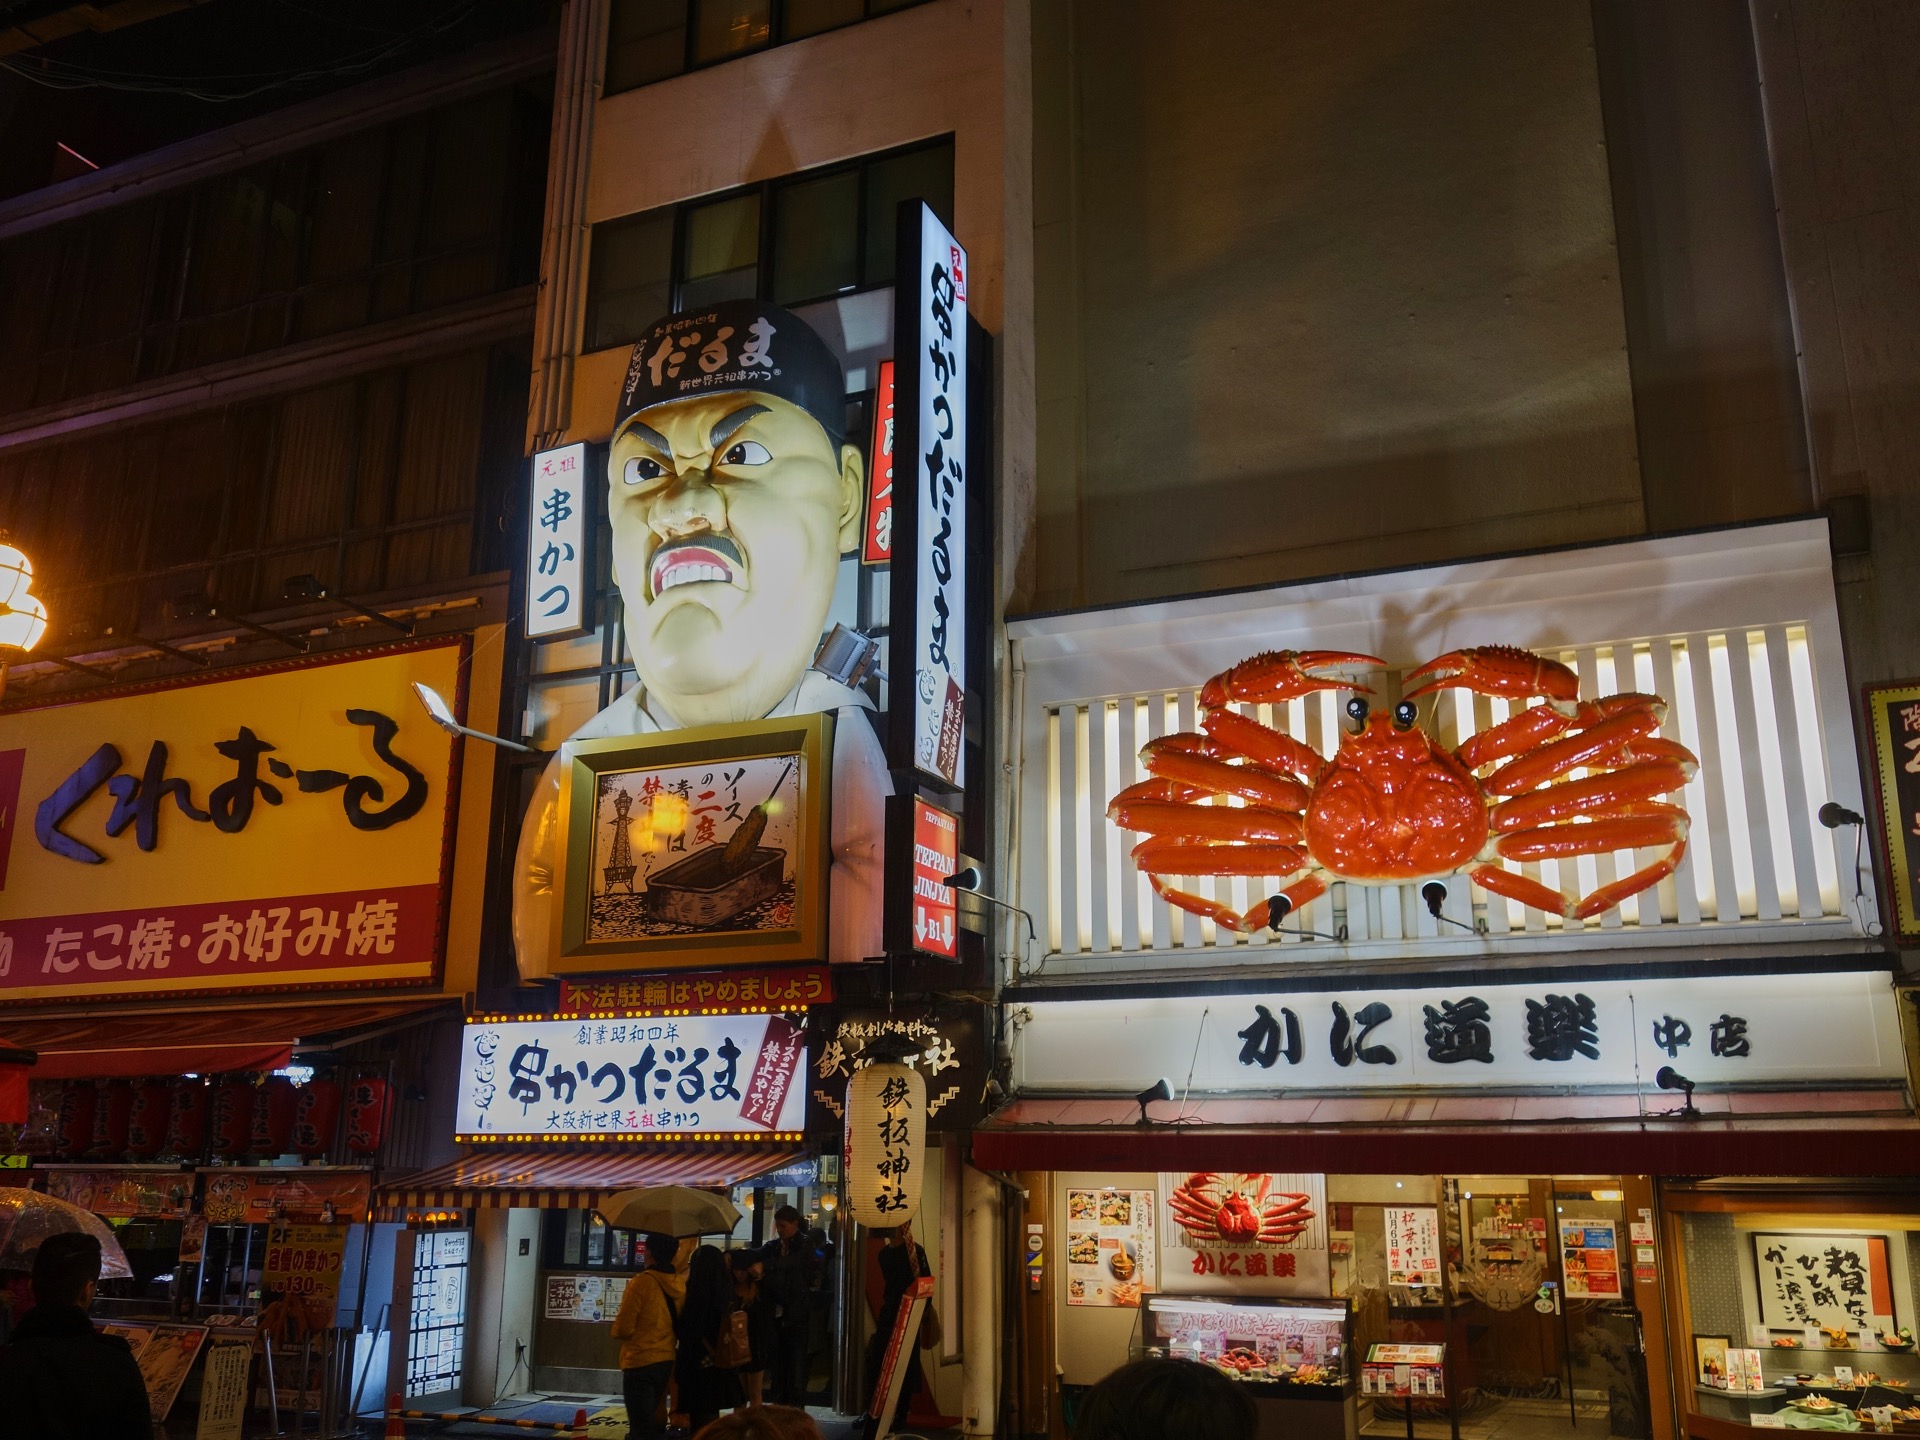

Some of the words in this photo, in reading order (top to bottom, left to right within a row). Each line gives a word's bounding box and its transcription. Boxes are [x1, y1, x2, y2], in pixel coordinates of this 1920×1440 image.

[647, 316, 777, 387] だるま
[540, 455, 577, 479] 元祖
[925, 262, 962, 673] 串かつだるま
[536, 488, 575, 617] 串かつ
[34, 708, 428, 865] くれおーる
[723, 767, 746, 822] ソース
[690, 772, 723, 847] の二度
[915, 843, 956, 875] TEPPAN
[914, 875, 951, 905] JINJYA
[928, 918, 941, 941] B1
[566, 977, 823, 1010] 不法駐輪はやめましょう
[575, 1023, 680, 1046] 創業昭和四年
[1652, 1012, 1753, 1058] 中店
[508, 1037, 742, 1117] 串かつだるま
[761, 1026, 804, 1125] ソースの二度漬けは
[546, 1109, 700, 1131] 大阪新世界元祖串かつ
[875, 1077, 912, 1214] 鉄板神社
[271, 1228, 292, 1243] 2F
[267, 1247, 341, 1273] 自慢の串かつ
[550, 1286, 575, 1298] ご予約
